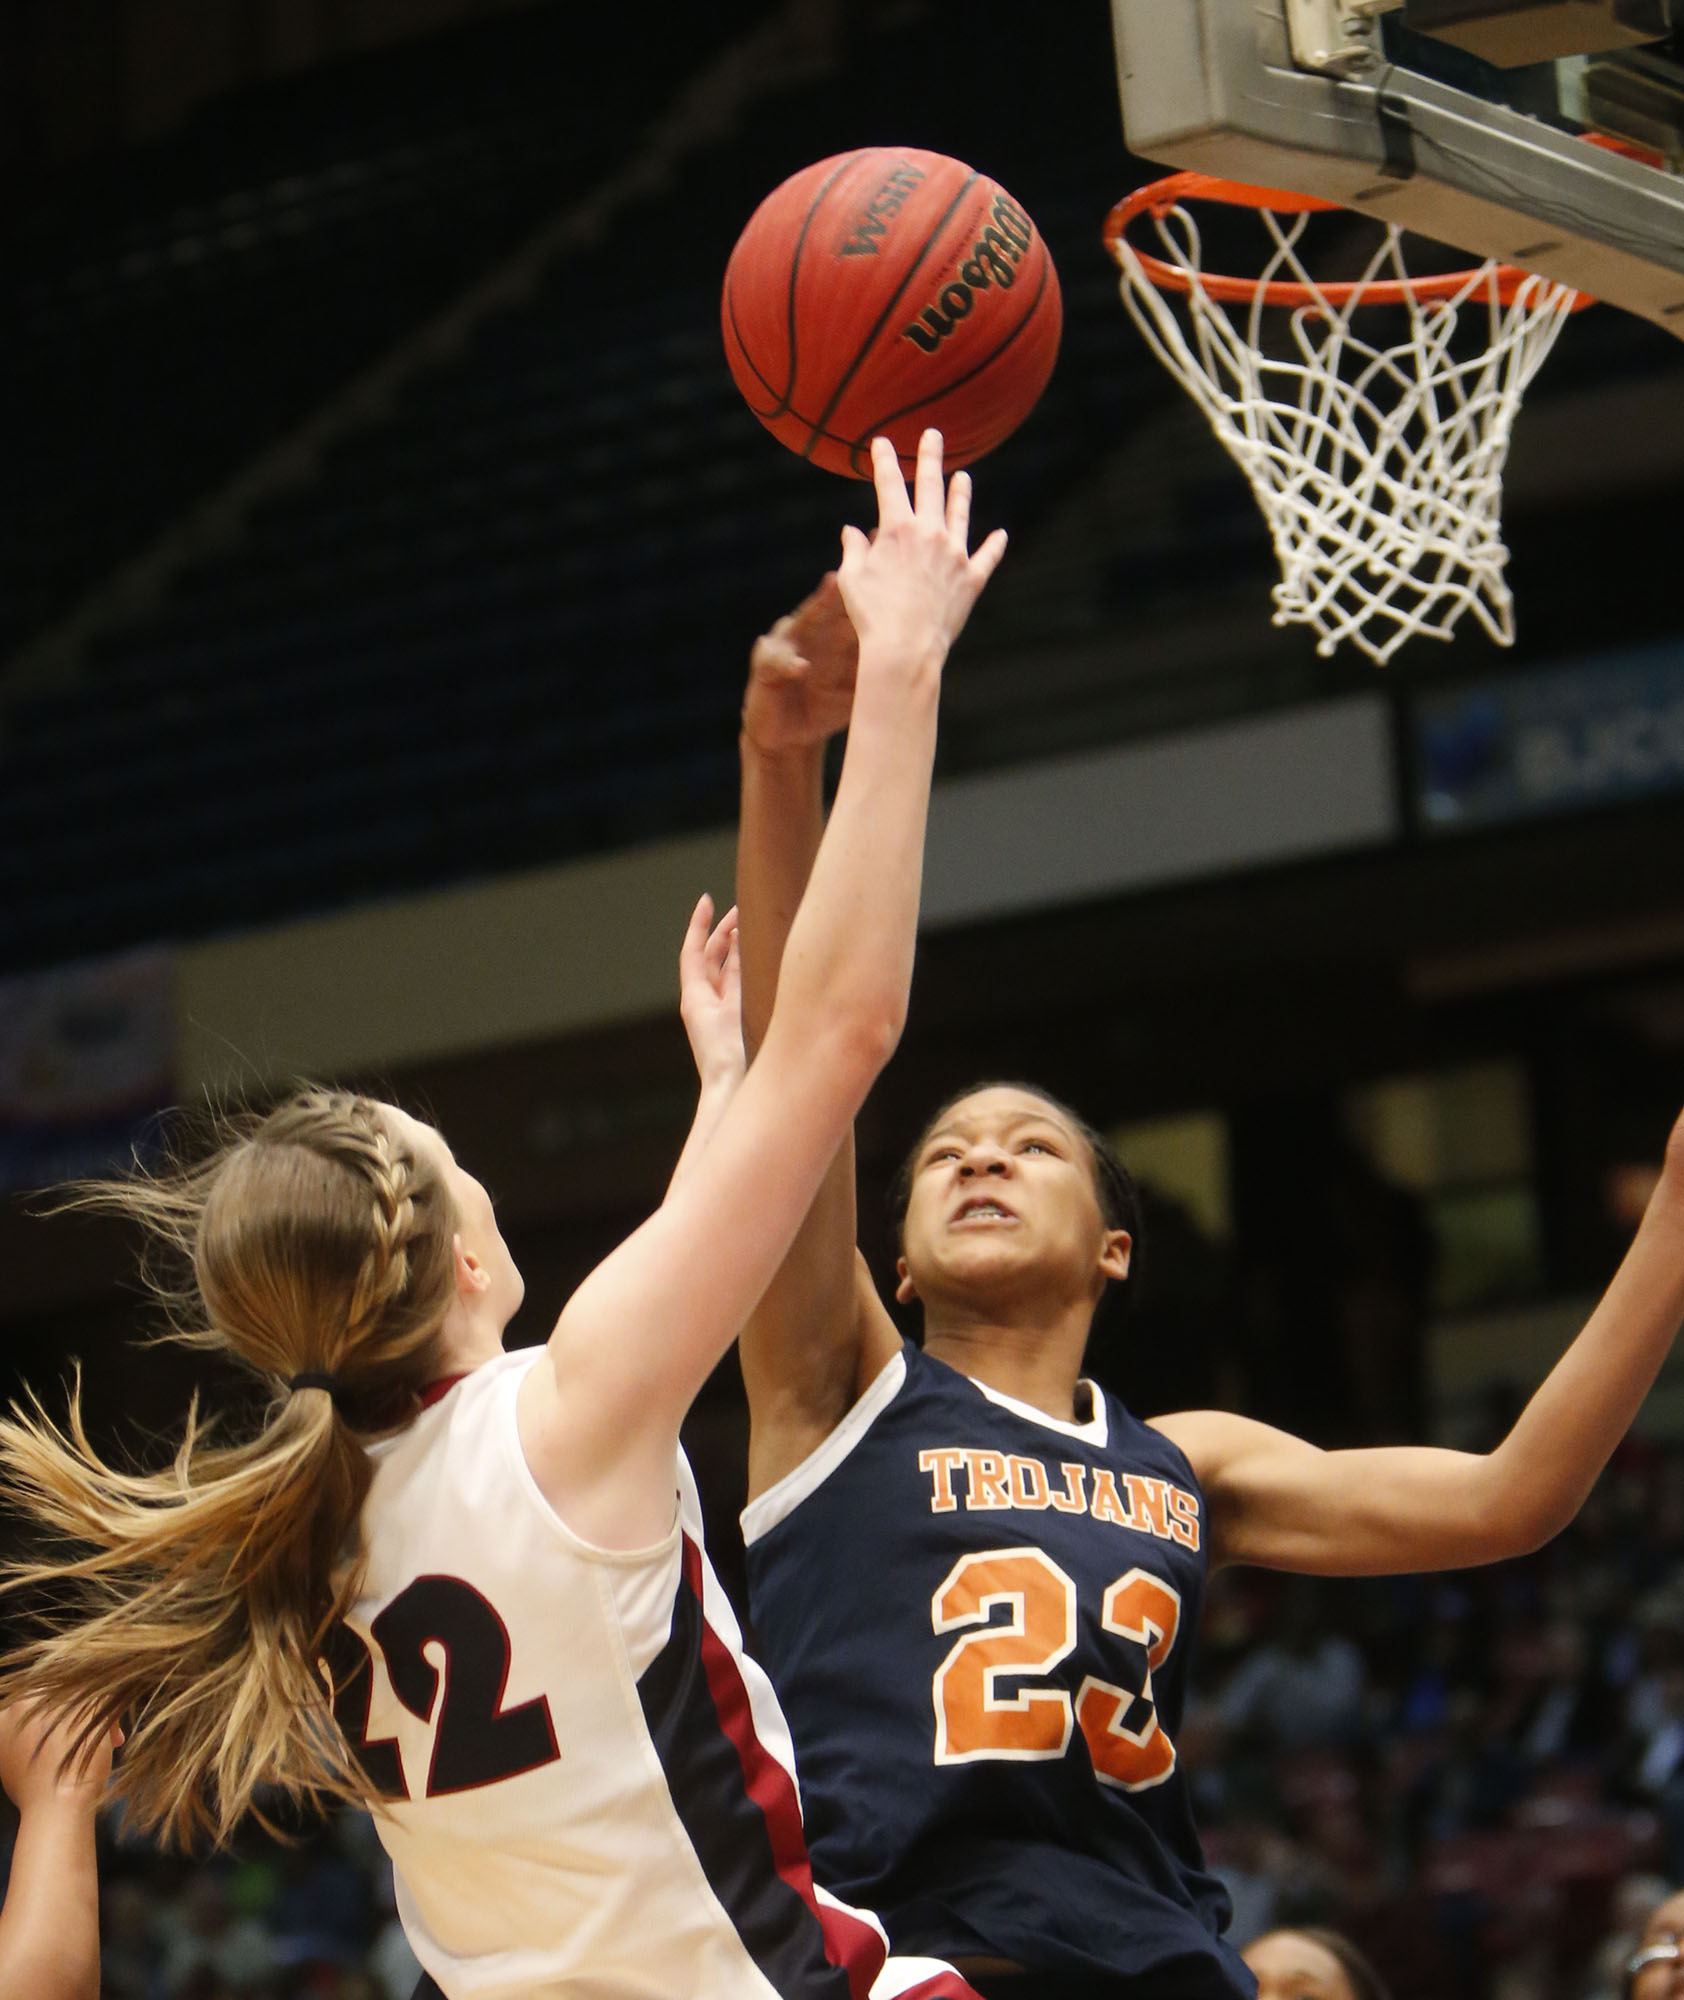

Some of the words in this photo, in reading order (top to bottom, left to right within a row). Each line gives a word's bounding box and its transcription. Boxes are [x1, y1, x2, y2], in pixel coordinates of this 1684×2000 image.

[902, 195, 1033, 353] Wilson
[919, 1447, 1200, 1552] TROJANS
[931, 1547, 1181, 1793] 23
